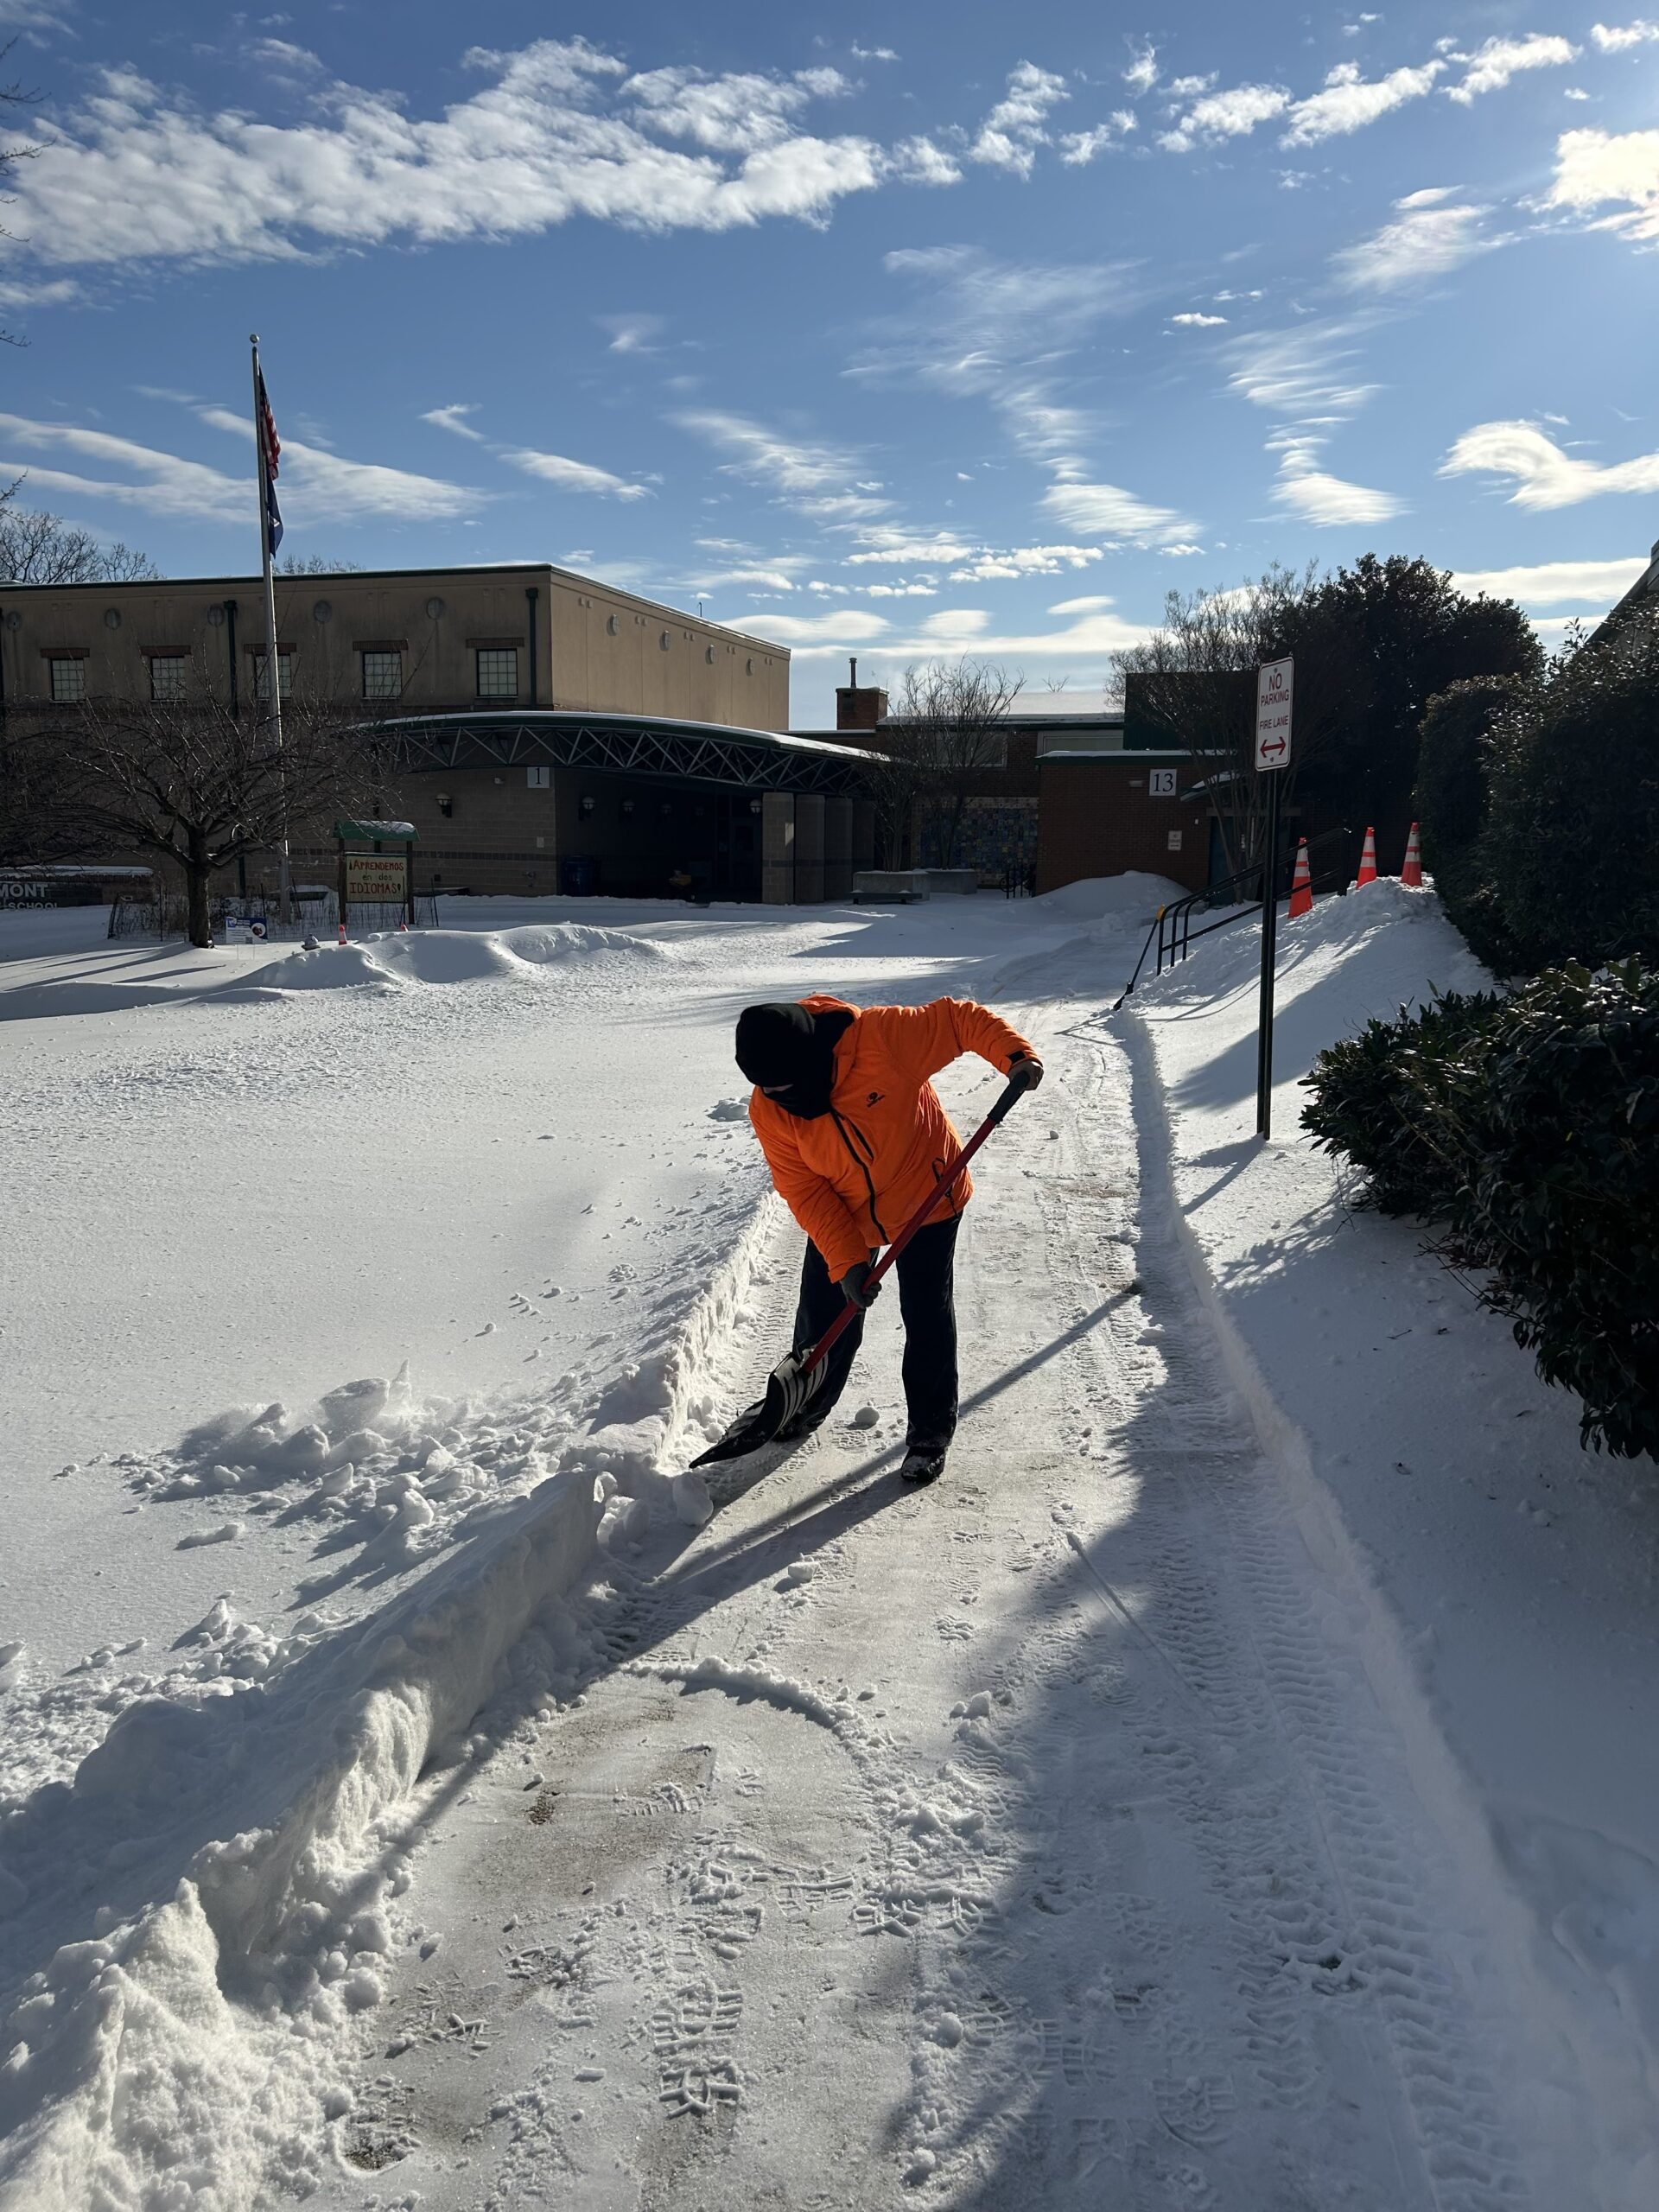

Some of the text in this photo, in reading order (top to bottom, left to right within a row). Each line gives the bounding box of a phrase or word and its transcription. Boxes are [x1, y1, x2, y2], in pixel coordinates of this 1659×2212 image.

[1268, 672, 1282, 691] NO
[1261, 690, 1289, 707] PARKING
[1260, 715, 1288, 730] FIRE LANE
[535, 766, 542, 785] 1
[1154, 772, 1173, 792] 13
[349, 882, 401, 894] IDIOMAS!
